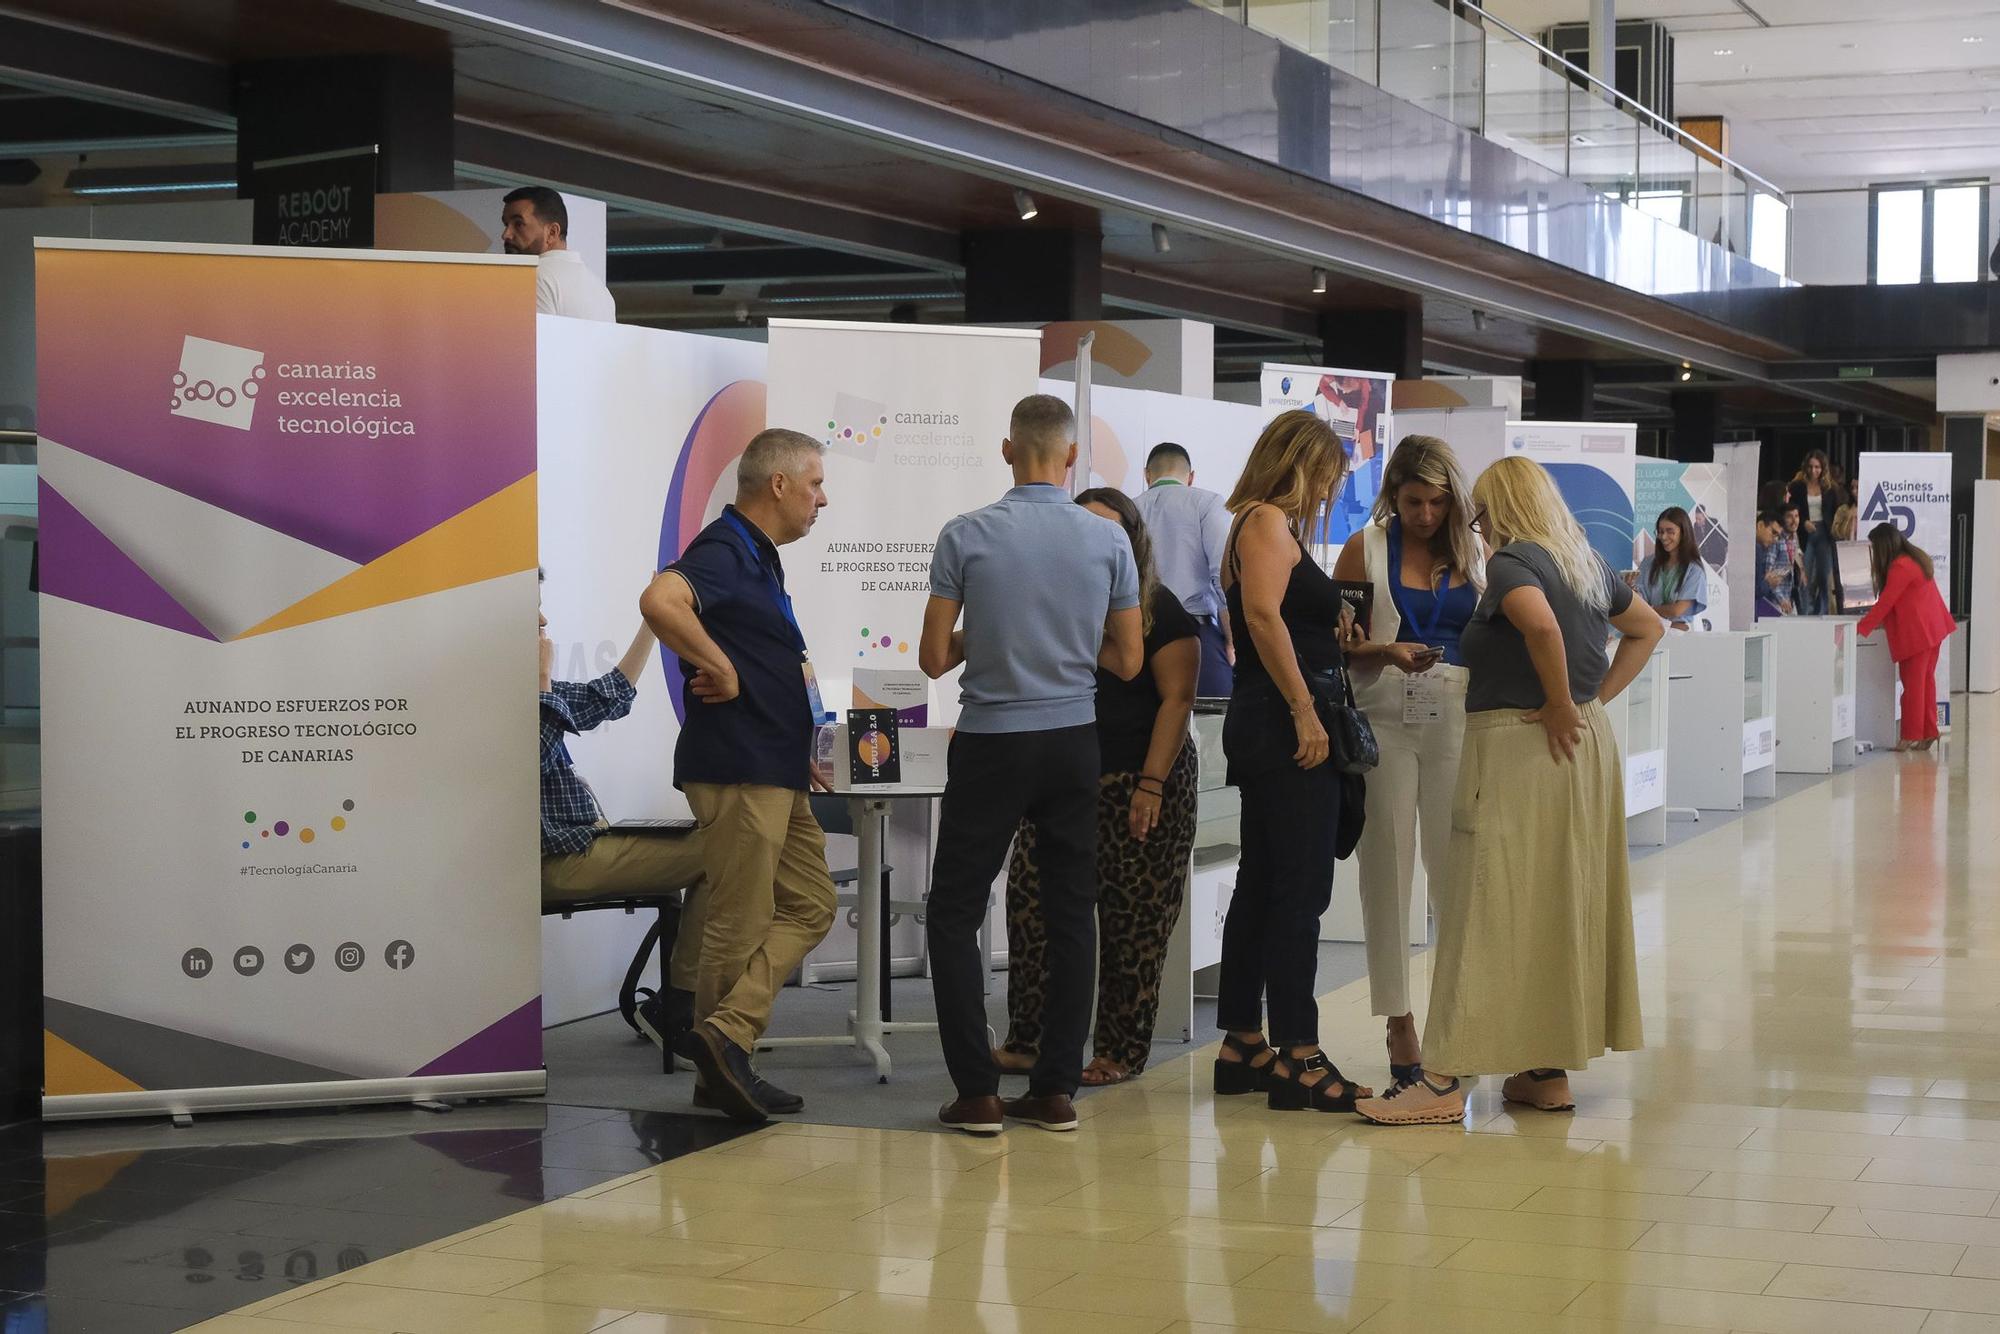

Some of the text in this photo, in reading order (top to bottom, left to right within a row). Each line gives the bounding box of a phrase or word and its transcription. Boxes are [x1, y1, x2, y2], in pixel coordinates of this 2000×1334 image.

[278, 184, 352, 217] REBOOT
[278, 216, 352, 246] ACADEMY
[277, 363, 377, 381] canarias
[277, 388, 402, 409] excelencia
[894, 410, 960, 426] canarias
[277, 415, 416, 439] tecnológica
[894, 431, 975, 446] excelencia
[893, 451, 985, 470] tecnológica
[1882, 480, 1934, 492] Business
[1887, 492, 1950, 503] Consultant
[827, 543, 936, 553] AUNANDO ESFUERZ
[820, 562, 834, 572] EL
[836, 562, 895, 572] PROGRESO
[861, 581, 931, 591] DE CANARIA
[183, 697, 409, 714] AUNANDO ESFUERZOS POR
[175, 720, 418, 740] EL PROGRESO TECNOLÓGICO
[869, 714, 880, 778] IMPULSA 2.0
[241, 748, 355, 764] DE CANARIAS
[239, 862, 358, 877] #TecnologíaCanaria
